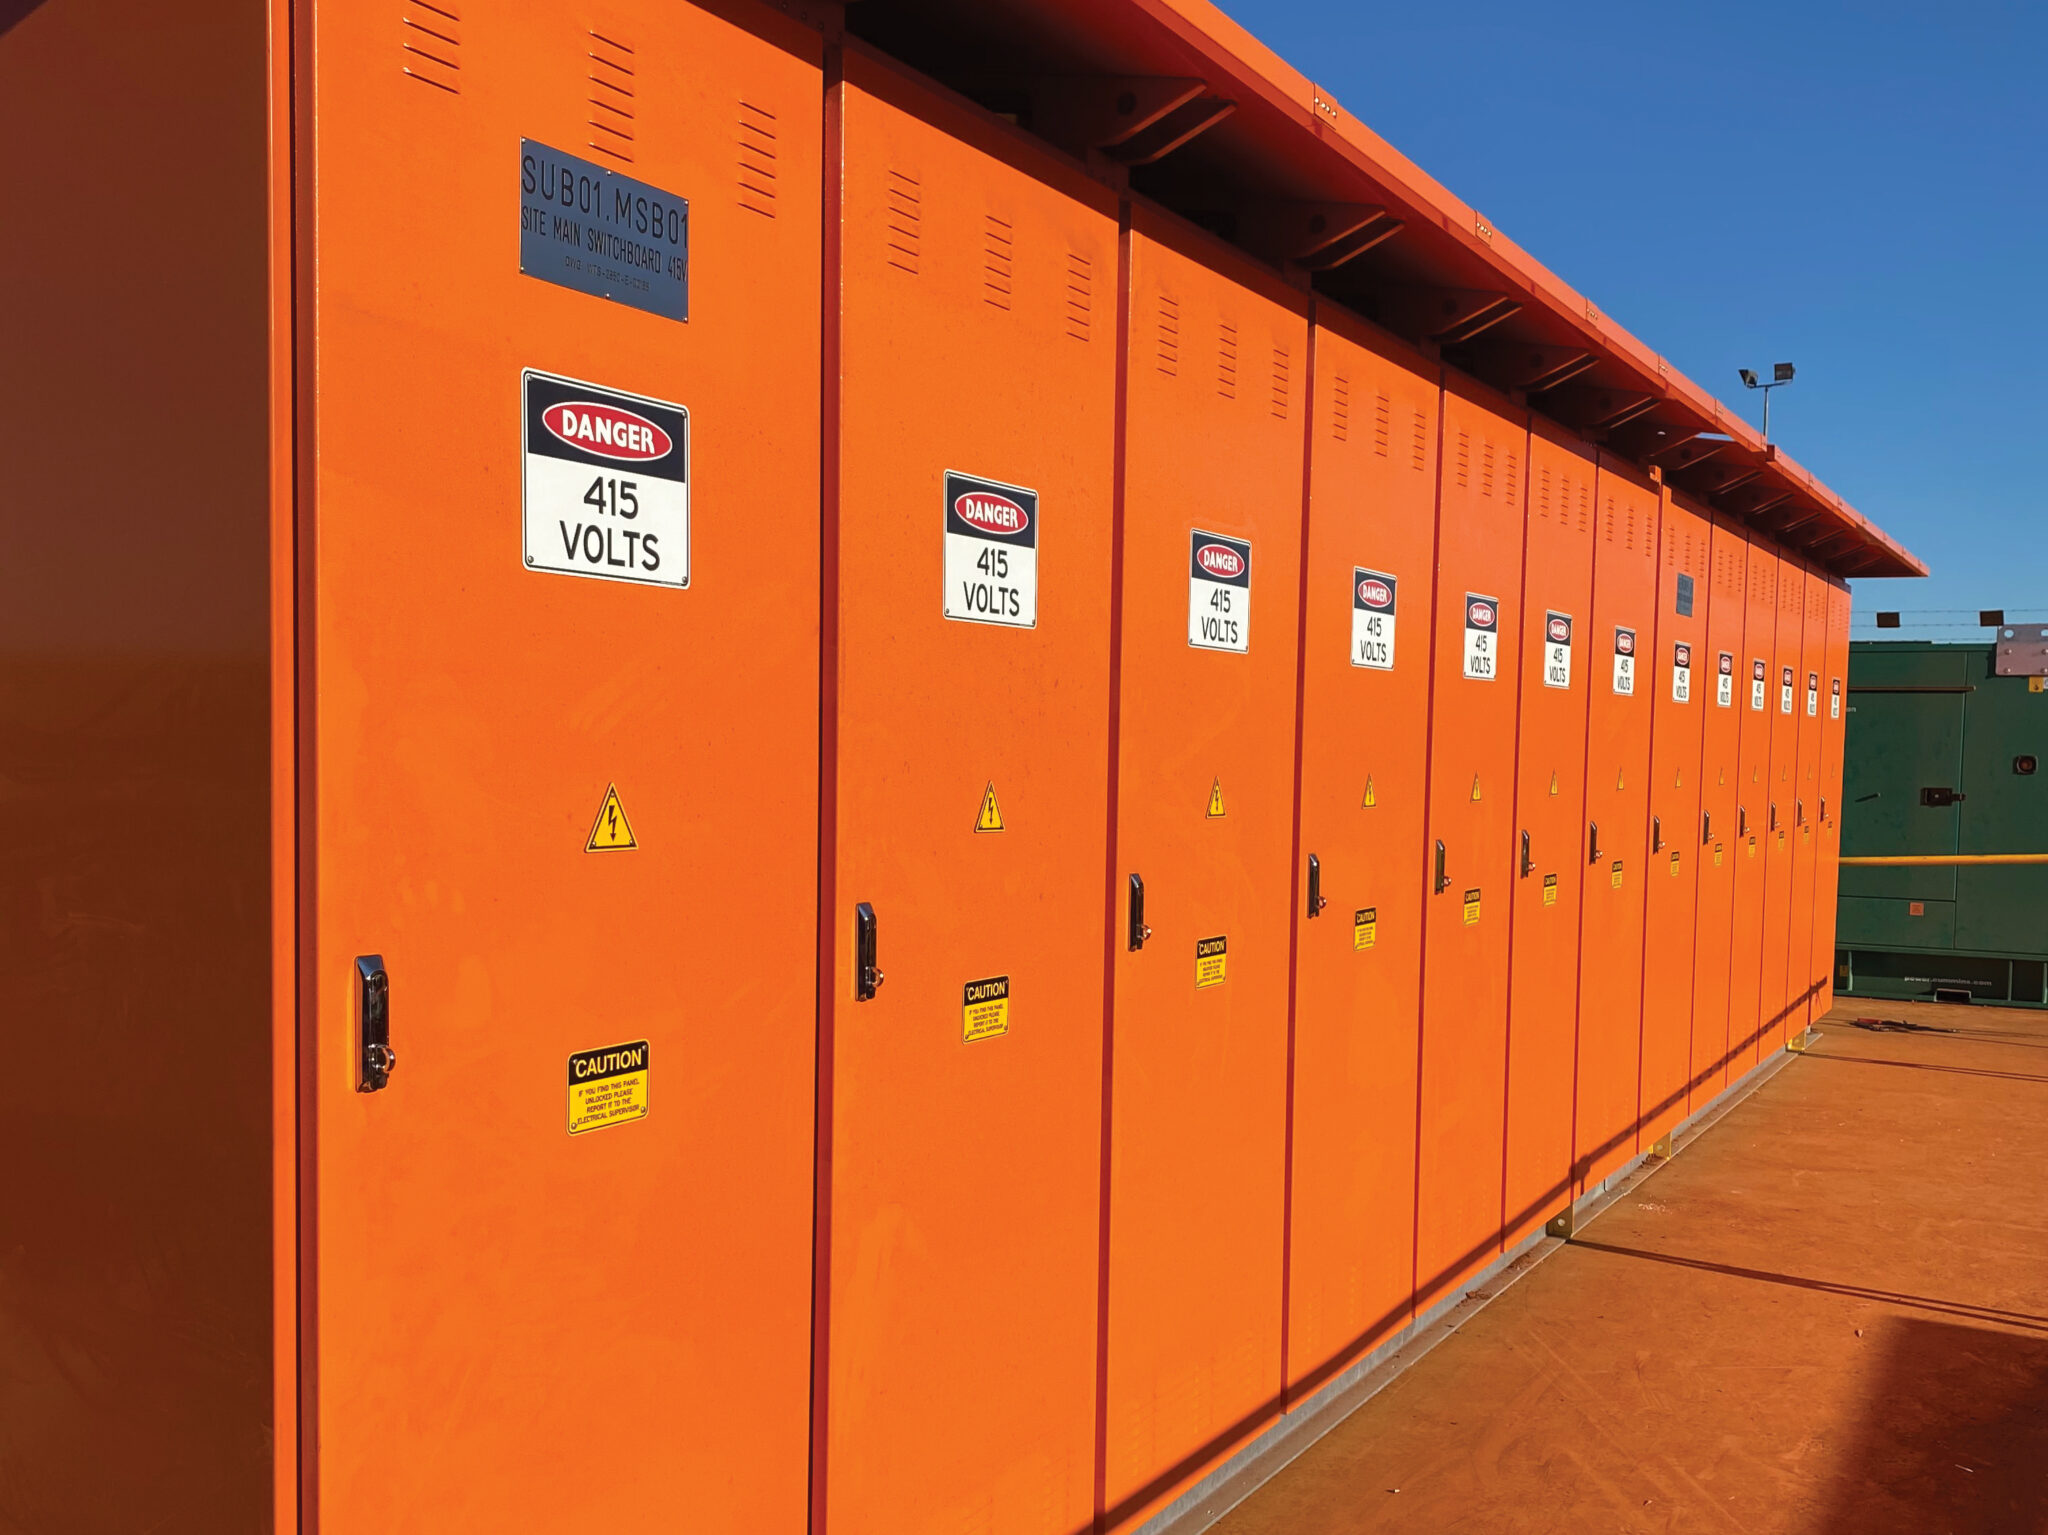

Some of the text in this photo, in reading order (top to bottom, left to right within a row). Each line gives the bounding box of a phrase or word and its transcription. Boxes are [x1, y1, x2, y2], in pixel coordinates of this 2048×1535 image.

[522, 155, 688, 249] SUB01.MSB01
[522, 205, 688, 283] SITE MAIN SWITCHBOARD 415V
[562, 408, 655, 454] DANGER
[583, 476, 639, 520] 415
[965, 498, 1019, 529] DANGER
[559, 520, 661, 571] VOLTS
[976, 547, 1009, 579] 415
[1203, 549, 1239, 573] DANGER
[963, 581, 1020, 617] VOLTS
[1210, 588, 1231, 613] 415
[1362, 584, 1388, 603] DANGER
[1201, 615, 1238, 644] VOLTS
[1367, 616, 1382, 637] 415
[1360, 639, 1387, 663] VOLTS
[1475, 634, 1487, 653] 415
[1470, 655, 1491, 674] VOLTS
[1549, 665, 1566, 683] VOLTS
[1198, 940, 1225, 955] CAUTION
[967, 981, 1005, 1001] CAUTION
[575, 1048, 642, 1078] CAUTION
[578, 1078, 640, 1097] IF YOU FIND THIS PANEL
[585, 1088, 633, 1105] UNLOCKED PLEASE
[577, 1104, 640, 1125] ELECTRICAL SUPERVISOR
[586, 1102, 607, 1114] REPORT
[622, 1097, 631, 1105] THE
